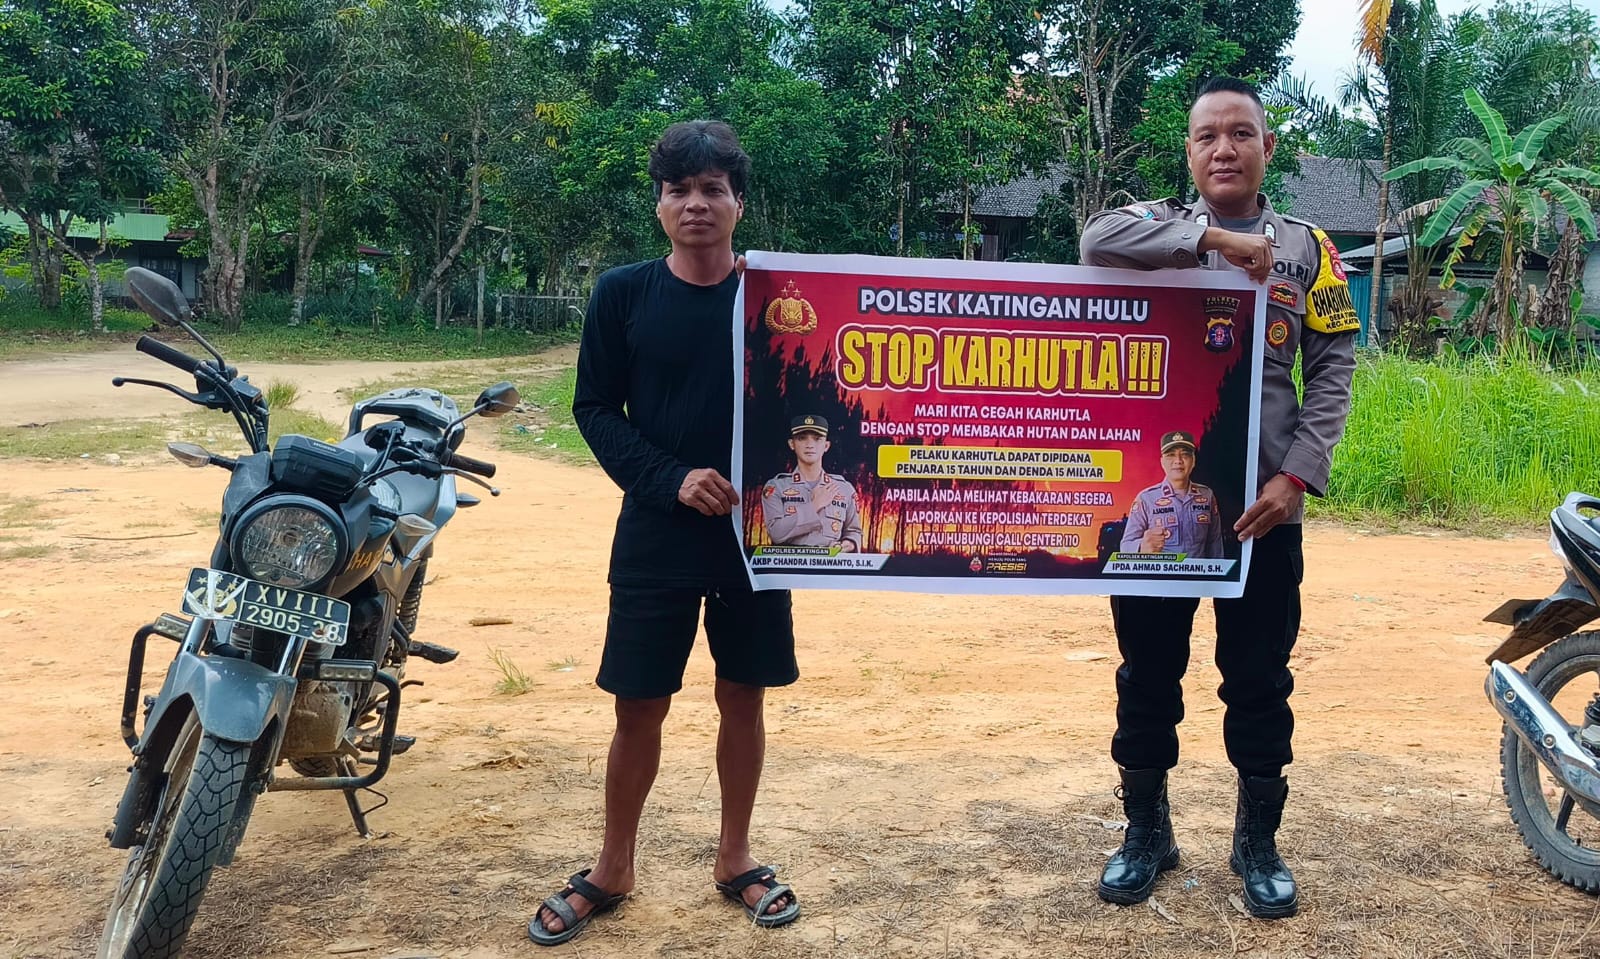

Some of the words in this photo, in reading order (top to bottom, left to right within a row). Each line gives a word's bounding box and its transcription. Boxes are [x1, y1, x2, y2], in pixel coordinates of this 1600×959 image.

[1273, 260, 1309, 283] OLRI
[860, 289, 952, 314] POLSEK
[958, 293, 1081, 319] KATINGAN
[1087, 299, 1149, 322] HULU
[842, 330, 934, 385] STOP
[943, 334, 1119, 391] KARHUTLA
[1128, 341, 1163, 392] !!!
[914, 404, 947, 417] MARI
[950, 405, 978, 418] KITA
[980, 406, 1023, 419] CEGAH
[1026, 407, 1091, 421] KARHUTLA
[861, 422, 914, 435] DENGAN
[917, 423, 950, 436] STOP
[952, 424, 1024, 438] MEMBAKAR
[1027, 426, 1068, 439] HUTAN
[1071, 427, 1097, 440] DAN
[1100, 428, 1141, 441] LAHAN
[910, 449, 949, 460] PELAKU
[952, 450, 1006, 461] KARHUTLA
[1008, 452, 1041, 462] DAPAT
[1042, 453, 1091, 463] DIPIDANA
[897, 463, 944, 474] PENJARA
[946, 465, 955, 474] 15
[957, 465, 992, 475] TAHUN
[995, 466, 1016, 476] DAN
[1020, 467, 1053, 477] DENDA
[1055, 467, 1064, 477] 15
[1066, 468, 1103, 478] MILYAR
[885, 488, 930, 502] APABILA
[932, 489, 961, 502] ANDA
[963, 490, 1008, 503] MELIHAT
[1010, 491, 1071, 504] KEBAKARAN
[1073, 492, 1113, 505] SEGERA
[905, 511, 963, 524] LAPORKAN
[965, 512, 978, 524] KE
[980, 512, 1040, 525] KEPOLISIAN
[1042, 513, 1092, 526] TERDEKAT
[918, 532, 944, 545] ATAU
[946, 533, 994, 546] HUBUNGI
[996, 533, 1023, 546] CALL
[1023, 534, 1063, 546] CENTER
[1064, 535, 1079, 547] 110
[752, 557, 772, 565] AKBP
[773, 557, 808, 566] CHANDRA
[809, 558, 855, 568] ISMAWANTO,
[855, 559, 874, 567] S.I.K.
[986, 562, 1027, 571] PRESISI
[1112, 563, 1131, 571] IPDA
[1132, 563, 1162, 571] AHMAD
[1163, 564, 1206, 573] SACHRANI,
[1207, 565, 1223, 573] S.H.
